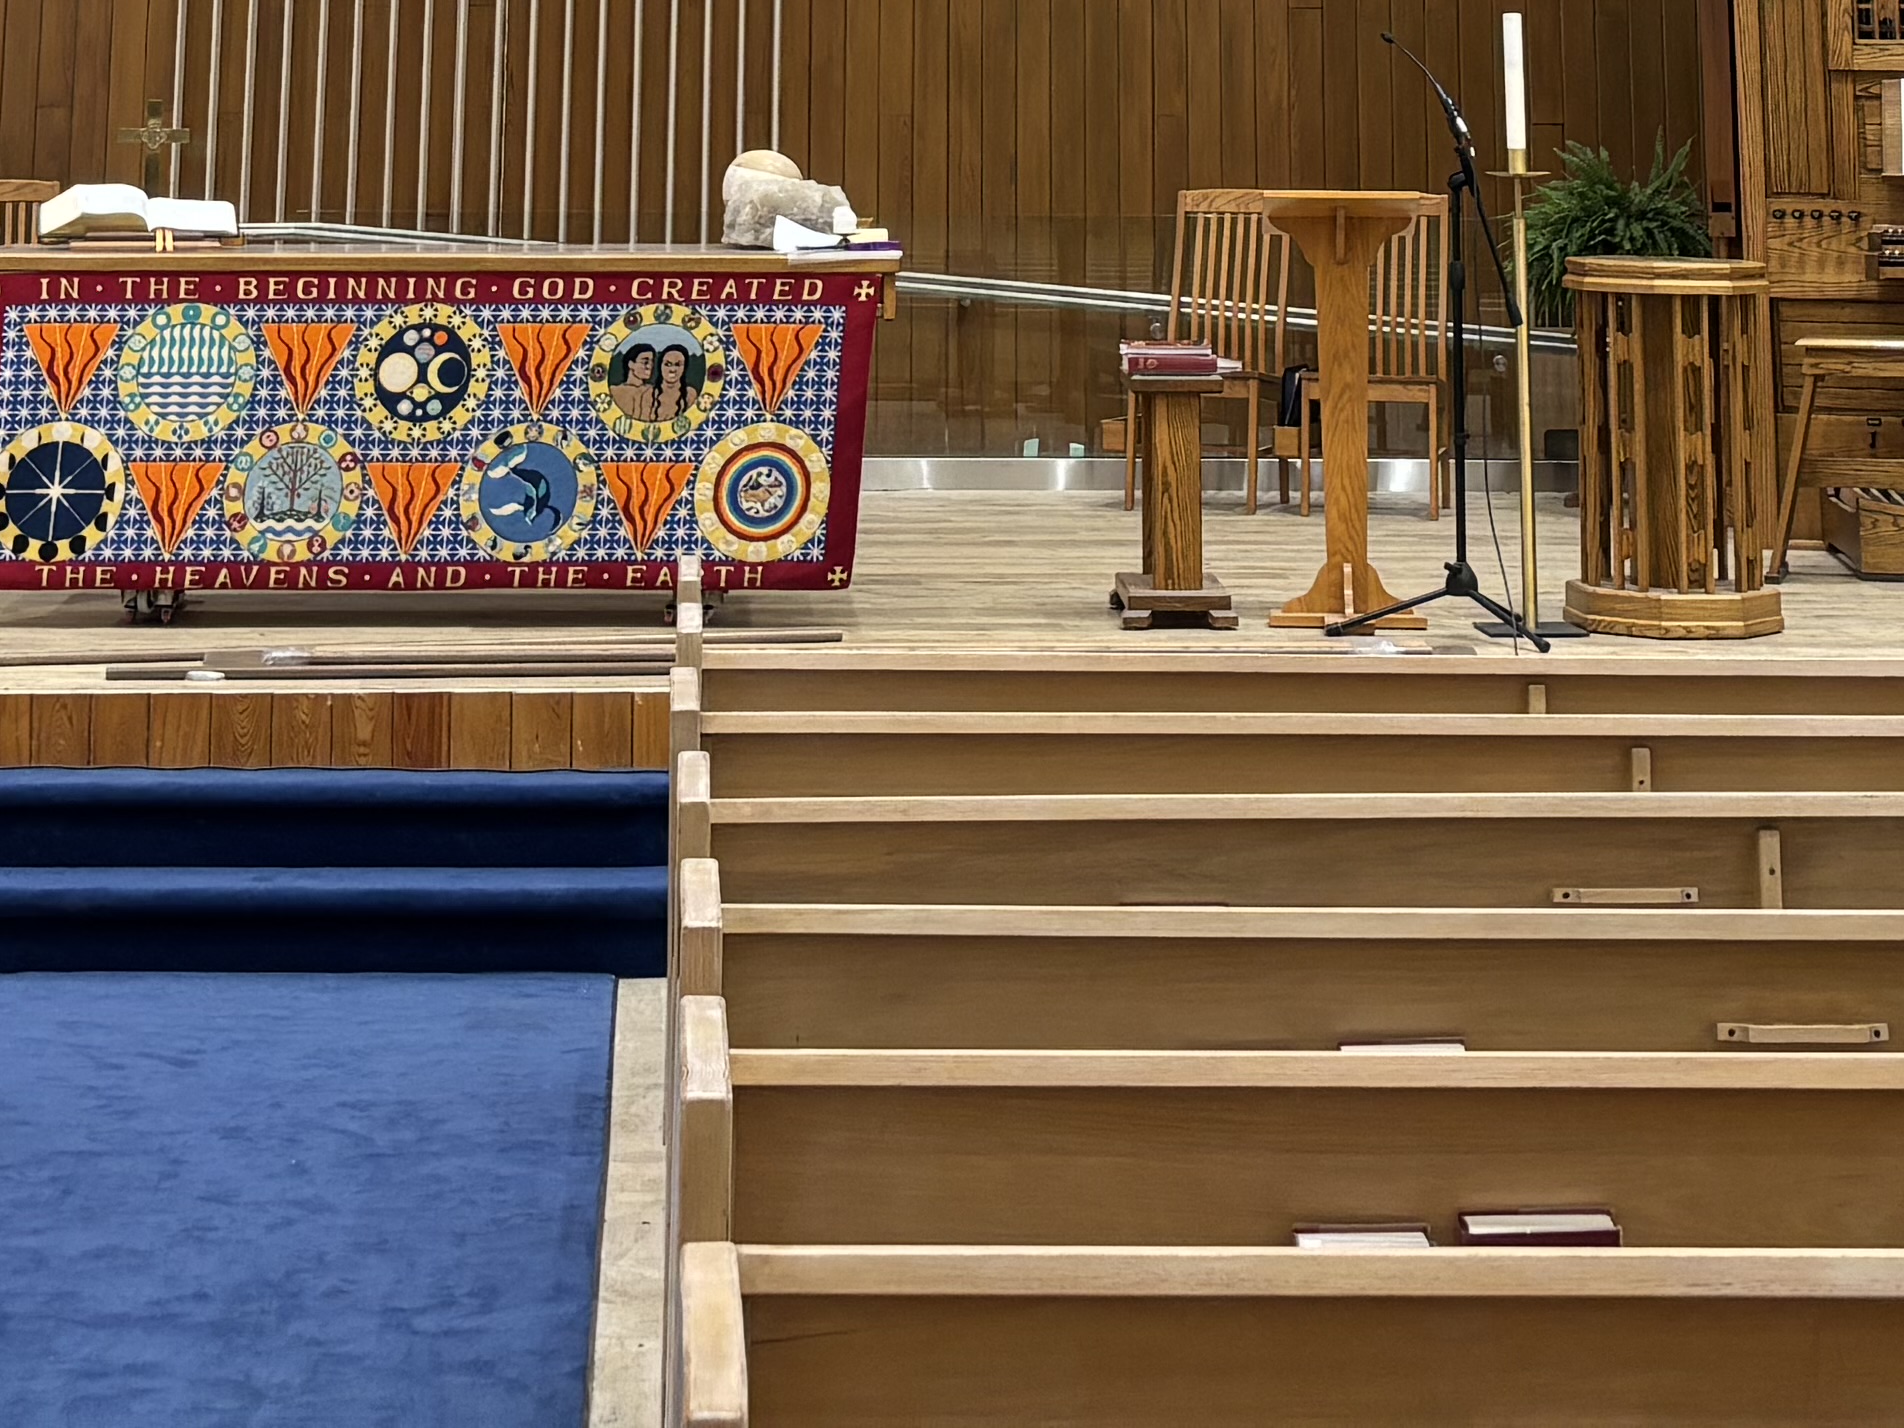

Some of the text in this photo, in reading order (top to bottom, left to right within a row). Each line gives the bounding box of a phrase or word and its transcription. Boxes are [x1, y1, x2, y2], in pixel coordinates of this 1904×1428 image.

[40, 276, 825, 301] IN THE BEGINNING GOD CREATED
[35, 564, 763, 589] THE HEAVENS AND THE EATH
